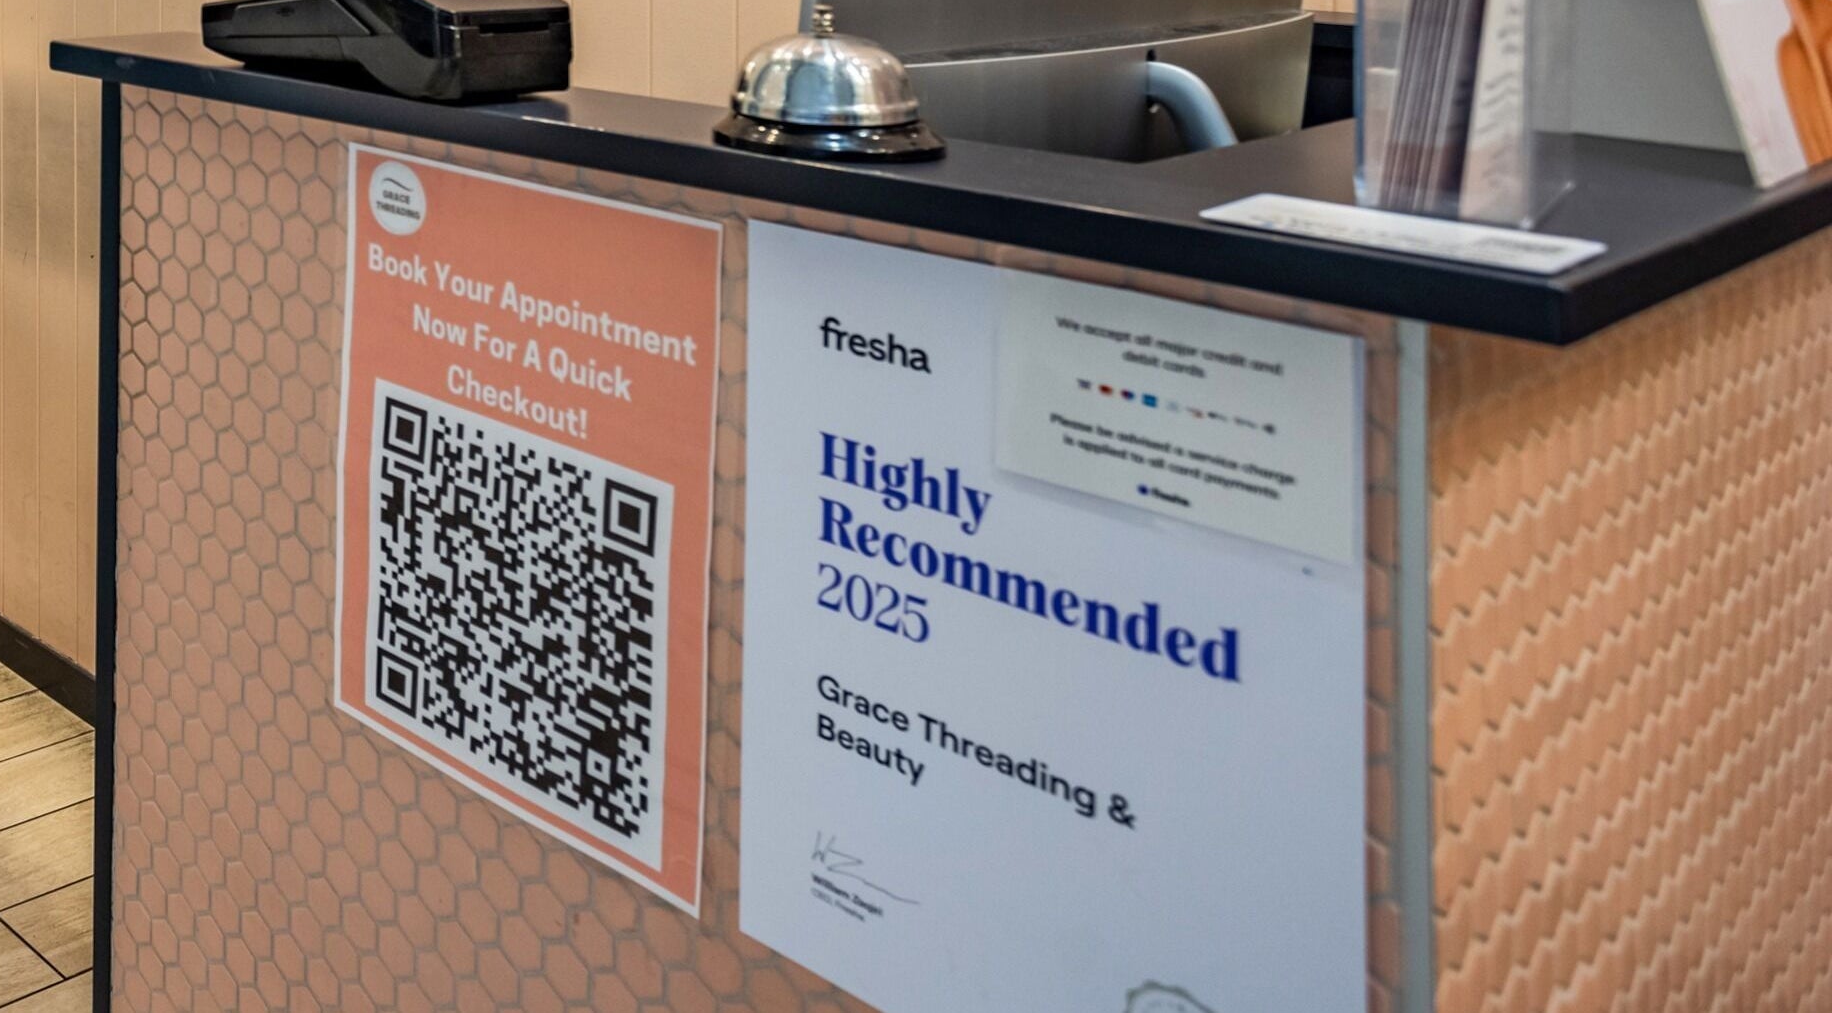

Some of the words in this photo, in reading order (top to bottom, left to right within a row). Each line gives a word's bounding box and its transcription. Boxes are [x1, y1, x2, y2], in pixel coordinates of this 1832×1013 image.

[375, 200, 421, 221] THREADING
[382, 189, 411, 205] GRACE
[369, 242, 428, 286] Book
[434, 261, 495, 305] Your
[500, 281, 698, 367] Appointment
[412, 303, 467, 347] Now
[473, 323, 516, 364] For
[522, 339, 543, 374] A
[548, 347, 632, 402] Quick
[820, 317, 932, 375] fresha
[1056, 315, 1081, 332] We
[1083, 320, 1131, 346] accept
[1134, 330, 1153, 347] all
[1155, 336, 1199, 360] major
[1202, 345, 1246, 370] credit
[1249, 354, 1284, 376] and
[1122, 348, 1160, 370] debit
[447, 363, 589, 438] Checkout!
[819, 431, 993, 535] Highly
[1048, 411, 1094, 434] Please
[1095, 423, 1113, 438] be
[1116, 428, 1171, 454] advised
[1173, 444, 1184, 457] a
[1186, 447, 1238, 471] service
[1240, 462, 1297, 486] charge
[1077, 438, 1128, 462] applied
[1130, 447, 1145, 464] to
[1147, 455, 1166, 471] all
[1167, 461, 1201, 481] card
[817, 562, 931, 644] 2025
[818, 496, 1241, 684] Recommended
[817, 712, 925, 786] Beauty
[817, 675, 910, 732] Grace
[917, 712, 1097, 819] Threading
[1108, 793, 1136, 830] &
